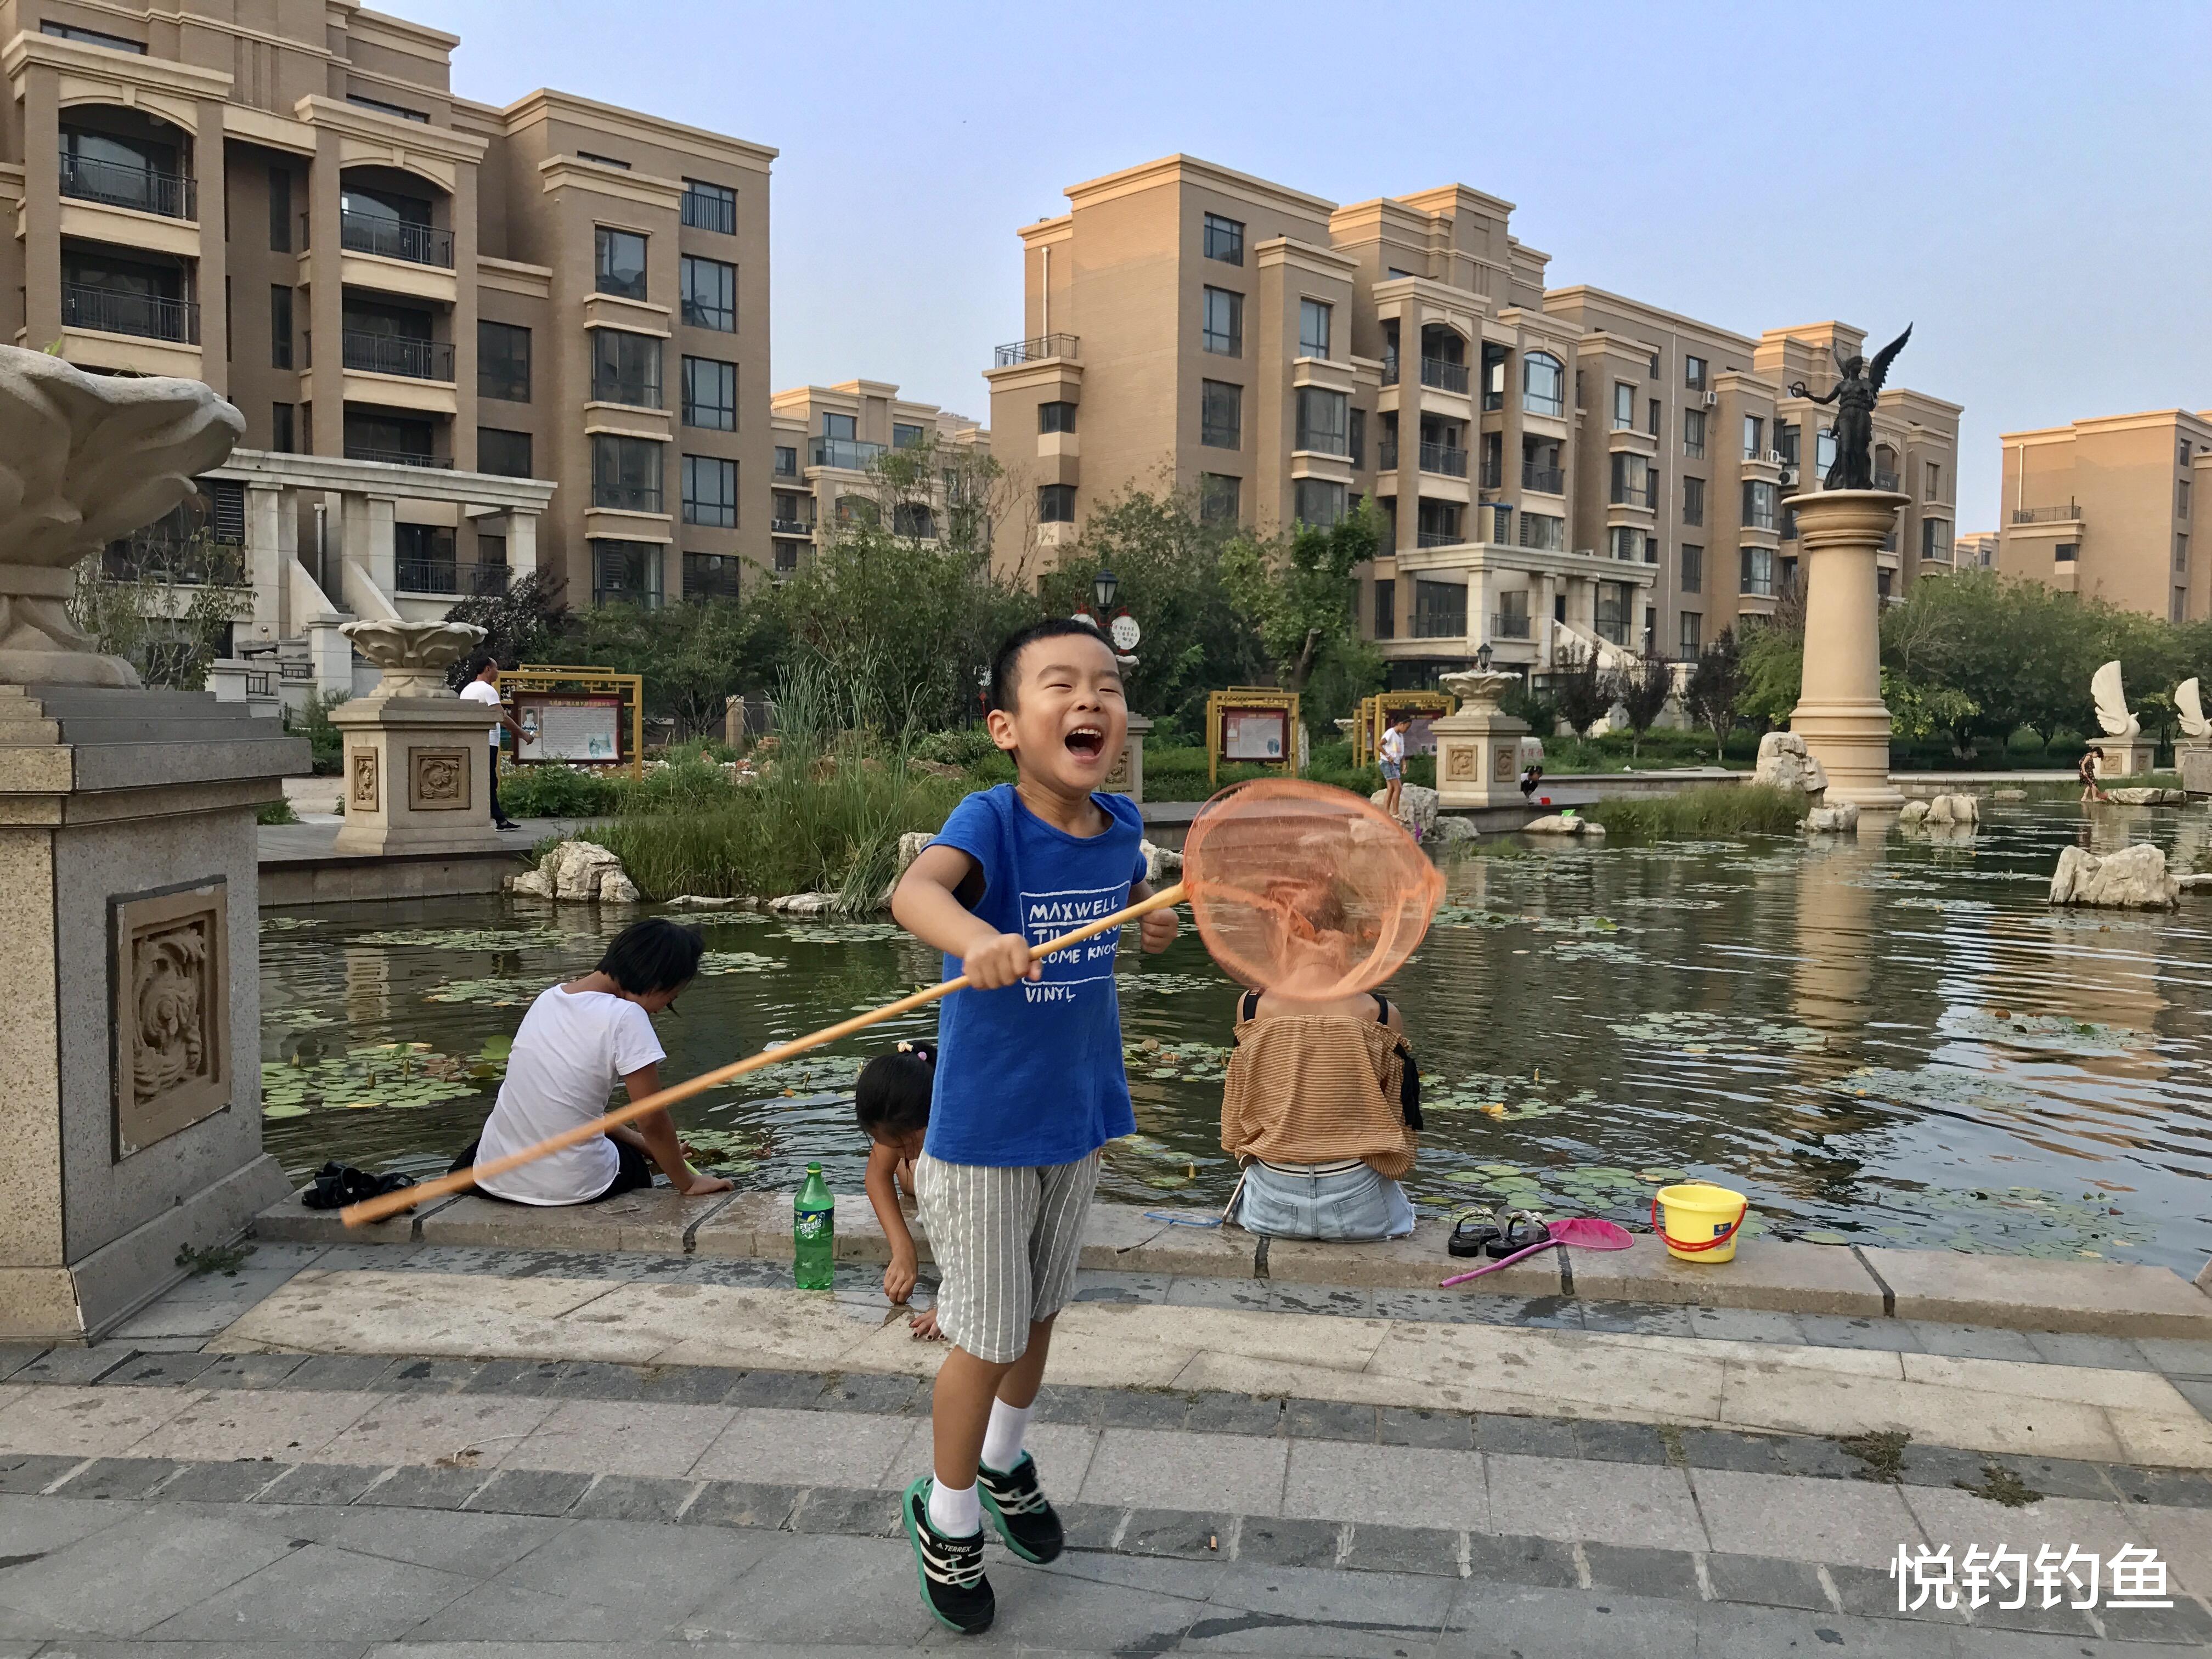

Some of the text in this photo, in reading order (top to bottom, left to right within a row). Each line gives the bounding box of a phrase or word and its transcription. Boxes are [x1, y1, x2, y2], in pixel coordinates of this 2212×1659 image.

[1029, 896, 1118, 922] MAXWELL
[1025, 986, 1076, 1003] VINYL
[944, 1544, 972, 1553] TERREX
